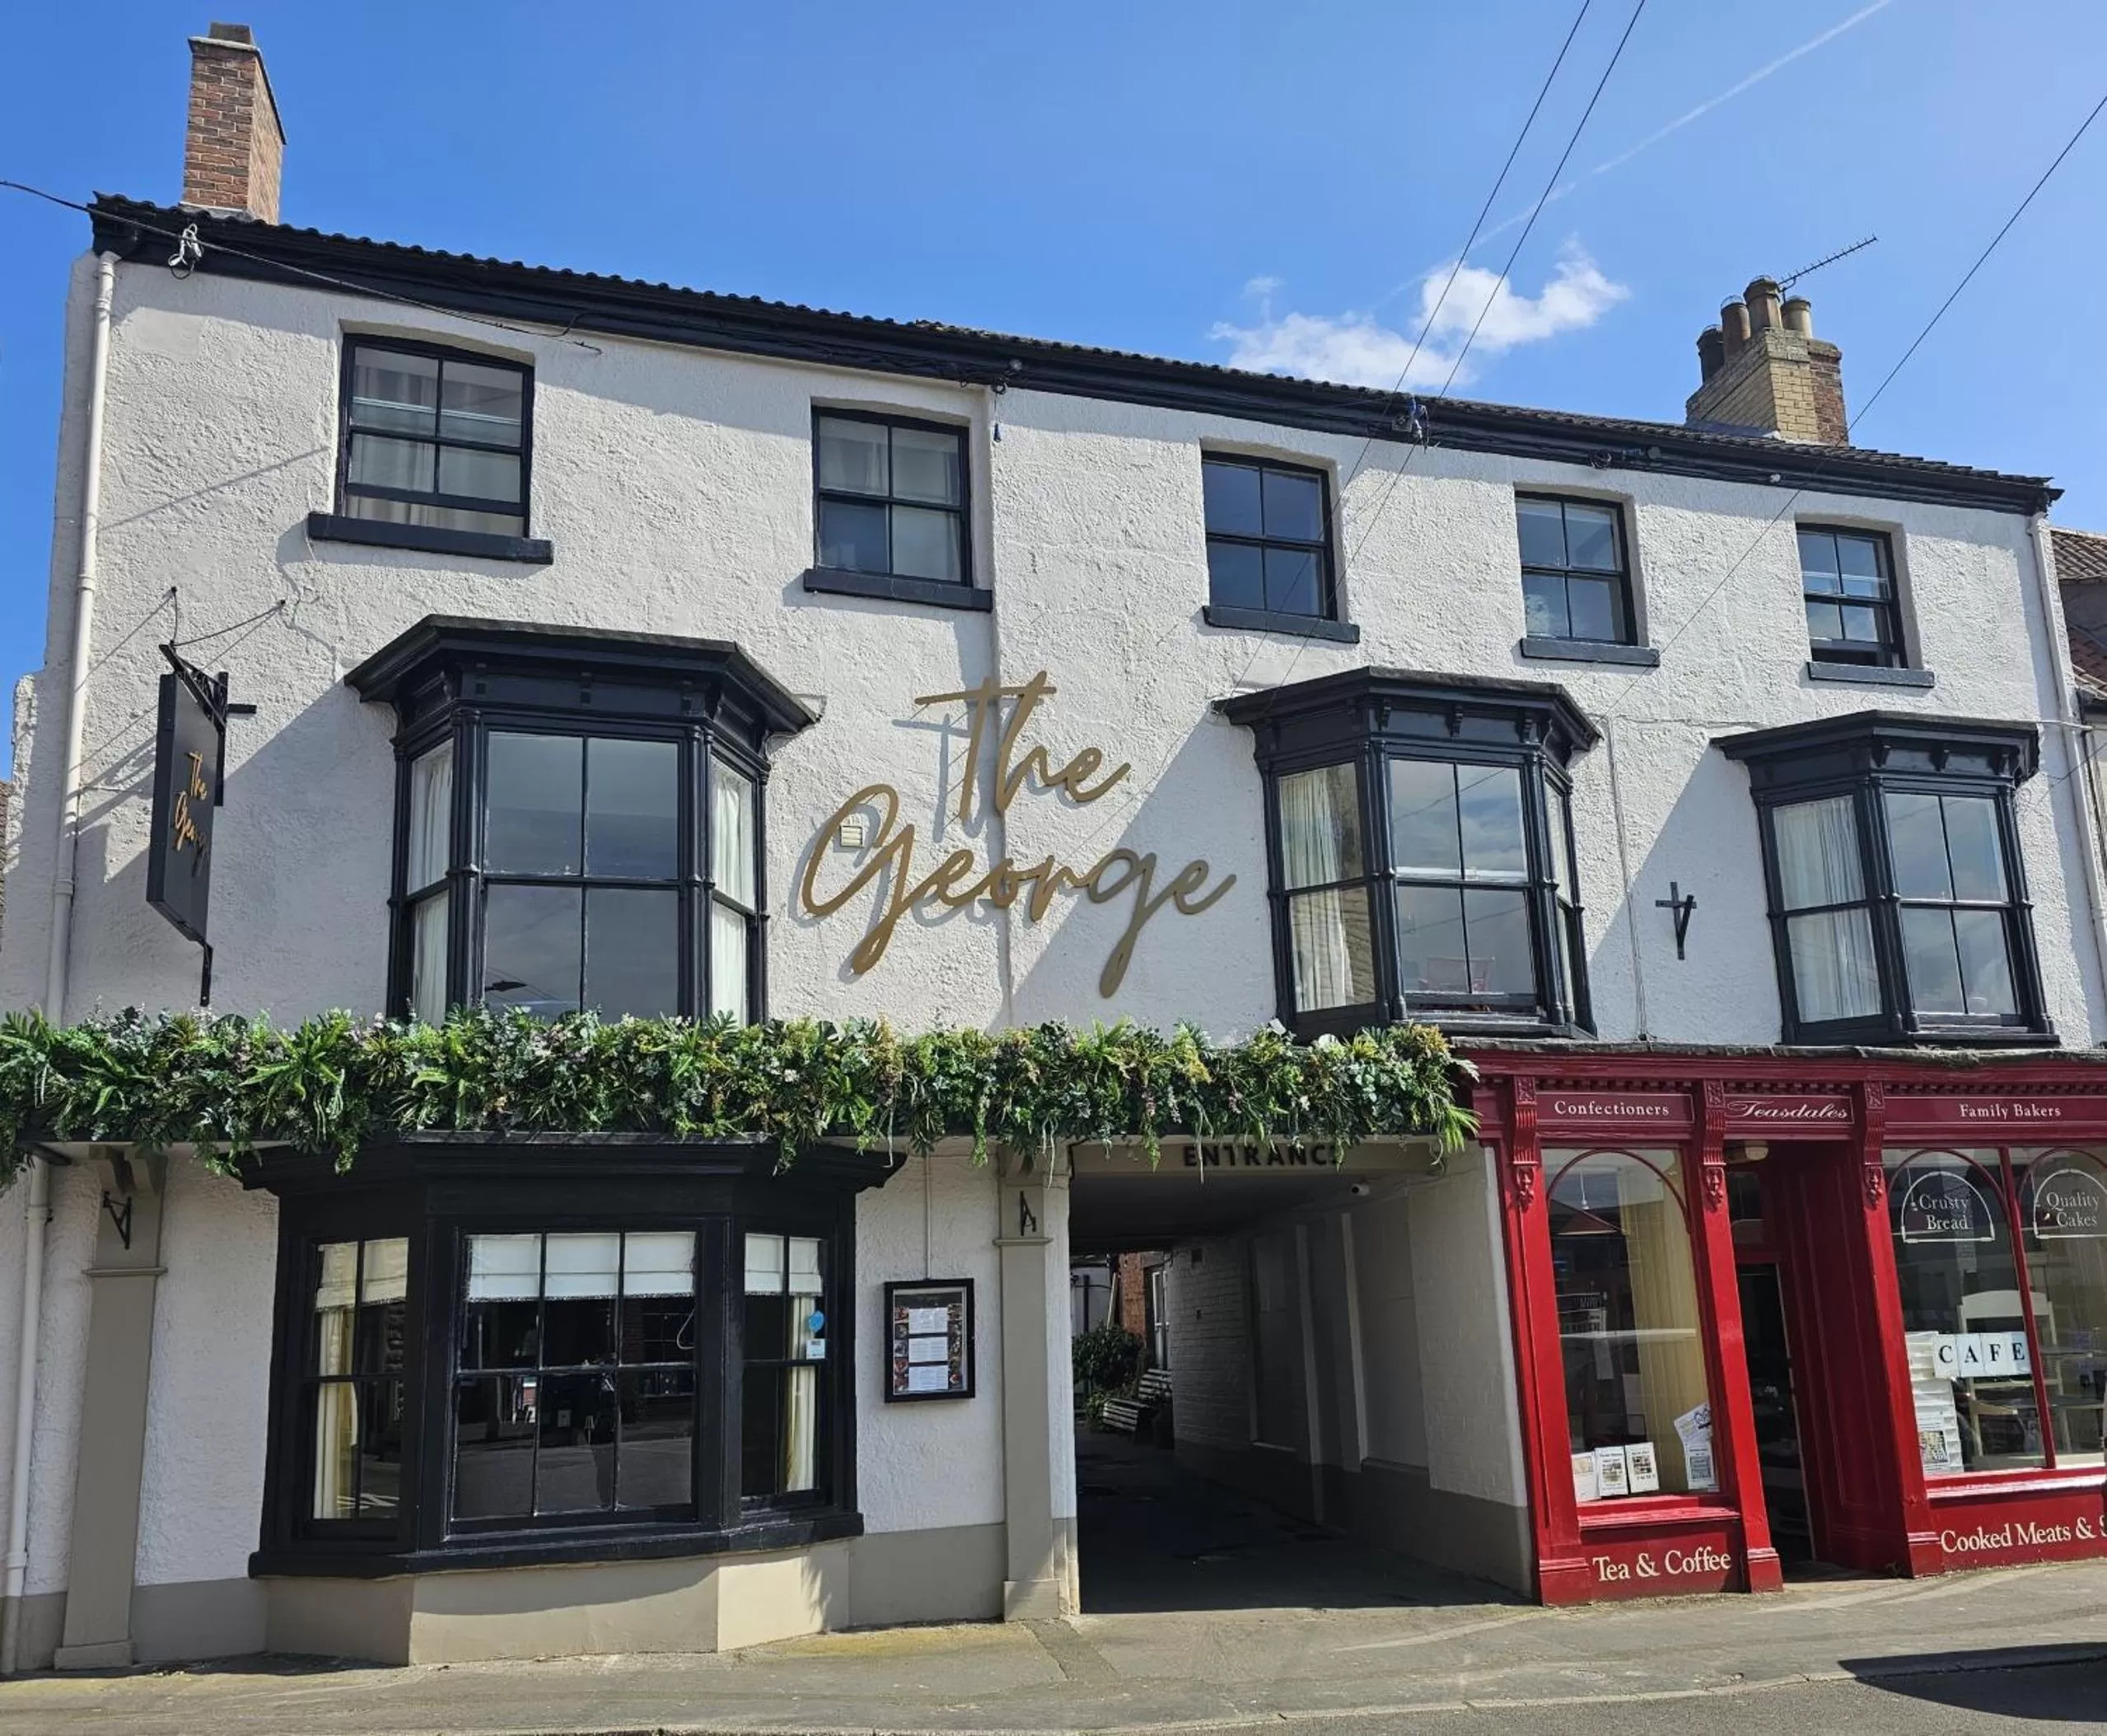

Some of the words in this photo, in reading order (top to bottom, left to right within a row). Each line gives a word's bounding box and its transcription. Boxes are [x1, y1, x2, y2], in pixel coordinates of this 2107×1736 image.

[801, 783, 1237, 999] George
[1554, 1100, 1670, 1116] Confectioners
[1725, 1100, 1848, 1120] Teasdales
[1959, 1103, 2008, 1120] Family
[2013, 1103, 2062, 1118] Bakers
[1183, 1144, 1343, 1167] ENTRANC
[1918, 1195, 1969, 1211] Crusty
[2046, 1192, 2100, 1211] Quality
[1925, 1214, 1969, 1230] Bread
[2056, 1212, 2097, 1228] Cakes
[1938, 1342, 2025, 1364] CAFE
[1941, 1523, 2012, 1553] Cooked
[2016, 1521, 2072, 1546] Meats
[2075, 1516, 2097, 1539] &
[1592, 1556, 1632, 1582] Tea
[1635, 1552, 1661, 1578] &
[1664, 1545, 1731, 1575] Coffee
